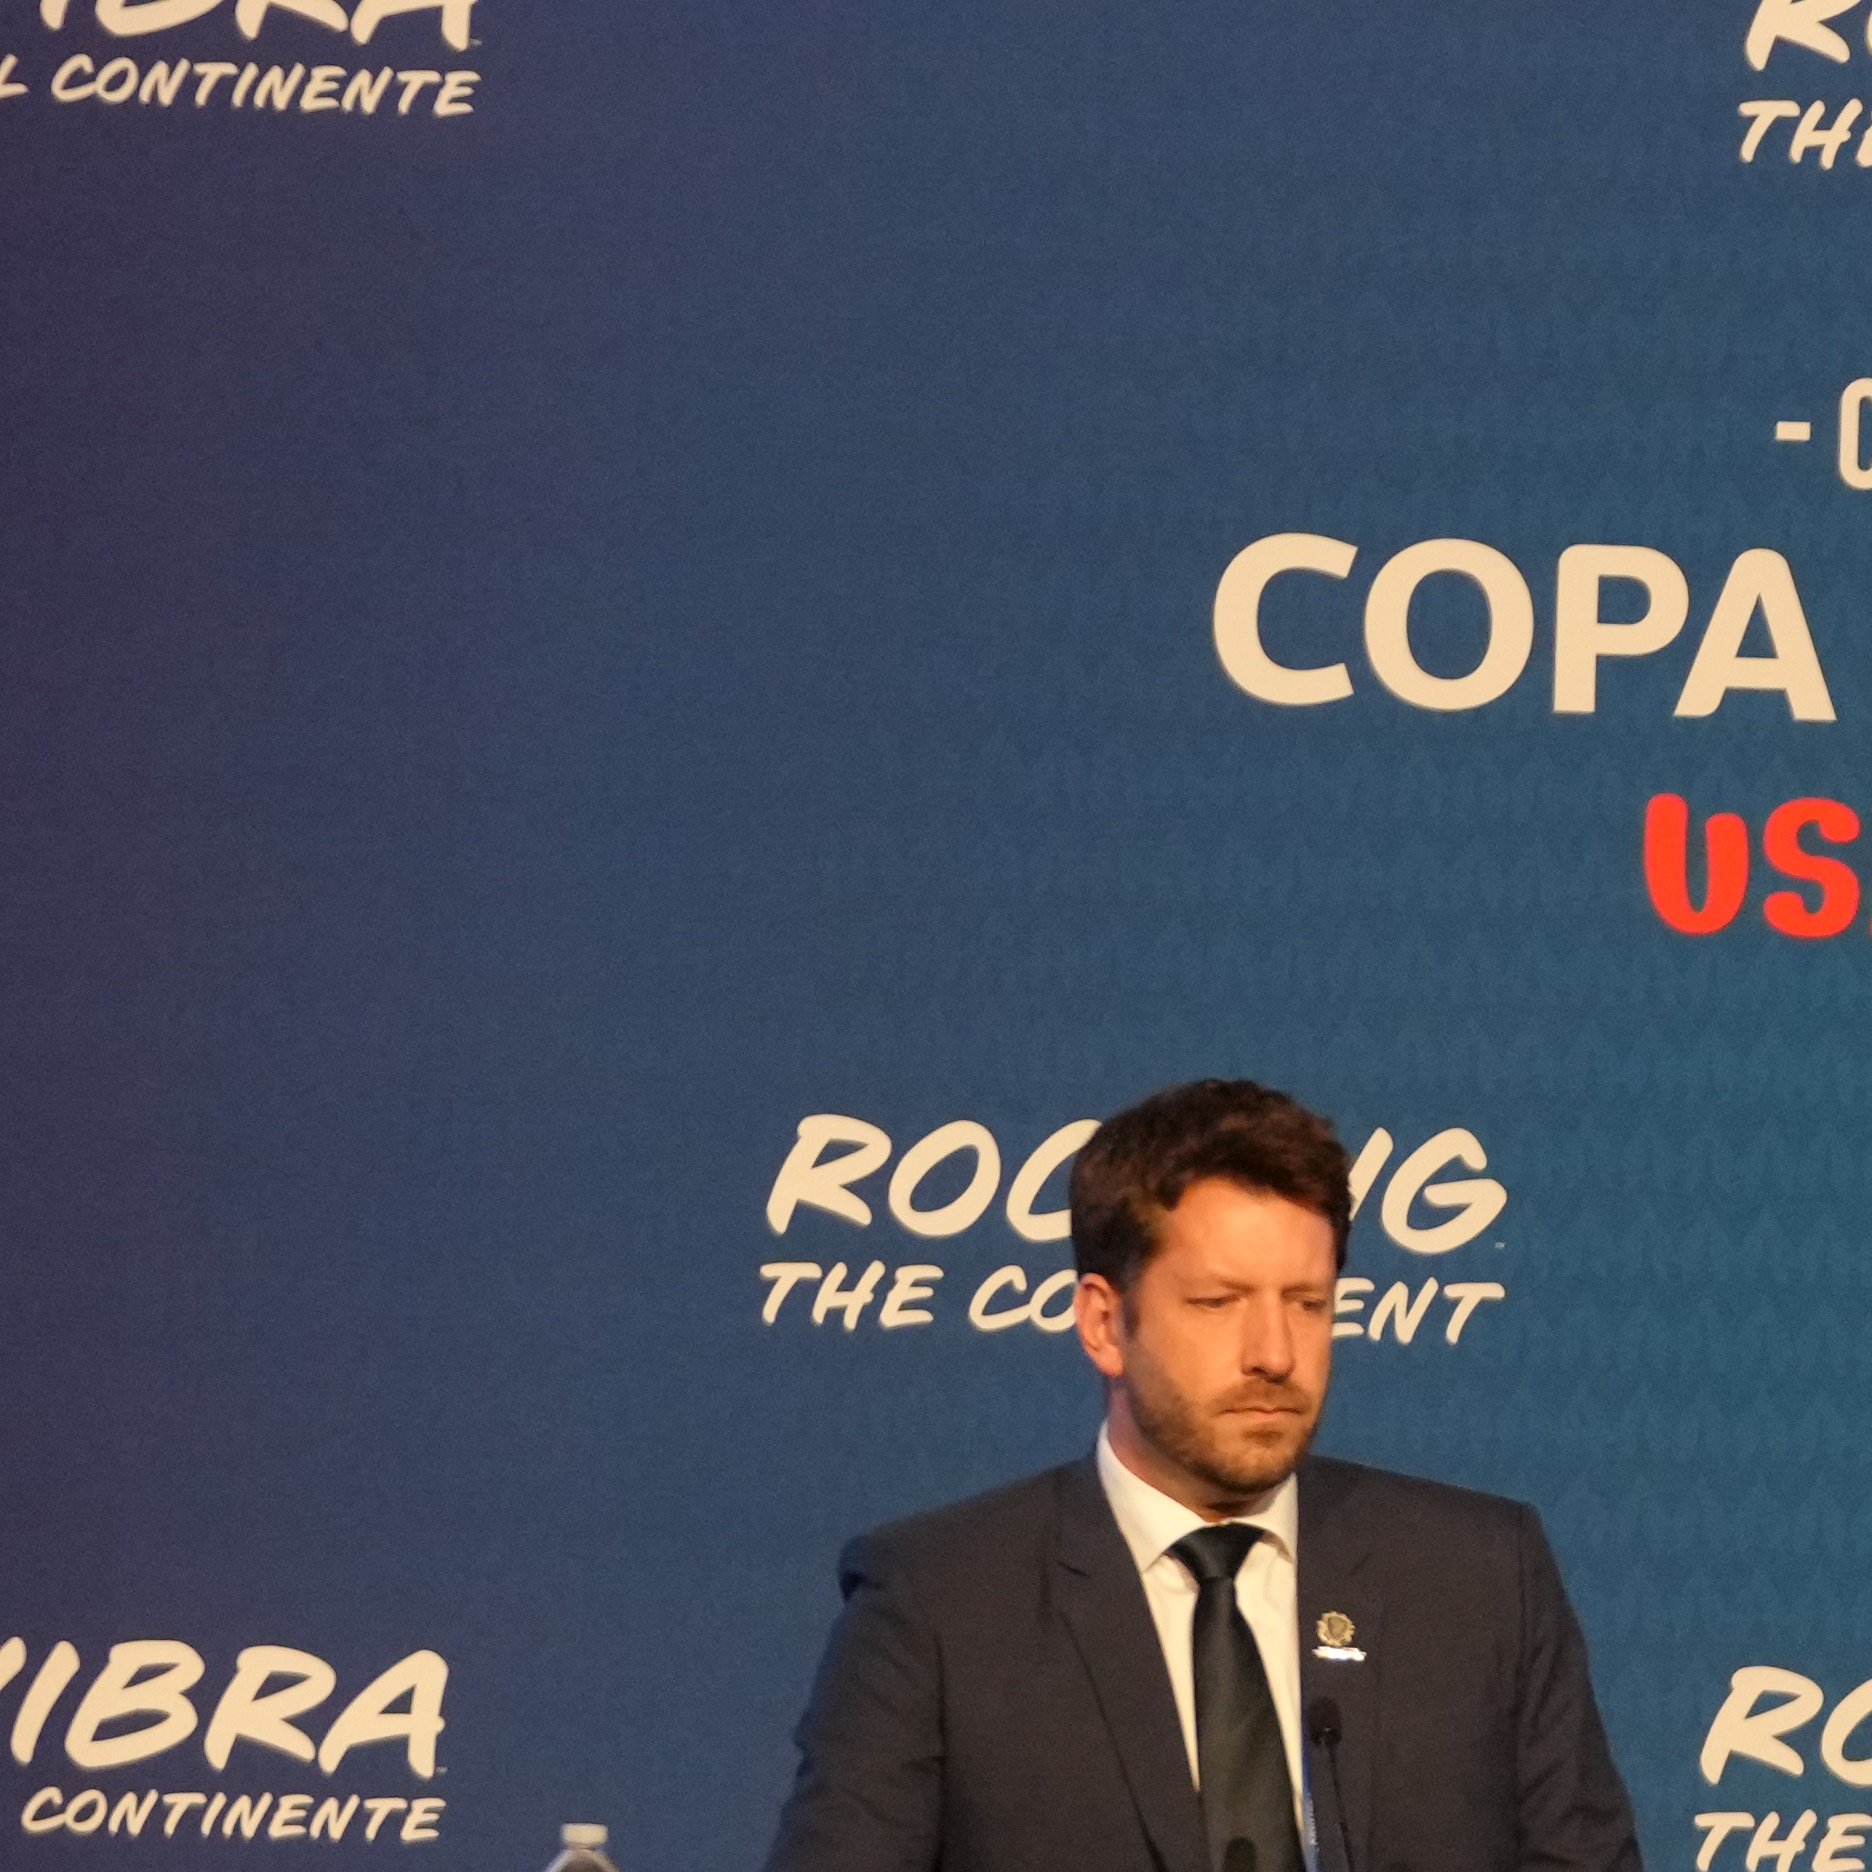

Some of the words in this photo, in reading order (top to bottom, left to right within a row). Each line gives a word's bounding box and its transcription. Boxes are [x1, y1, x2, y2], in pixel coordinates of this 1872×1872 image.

[51, 54, 481, 117] CONTINENTE
[1212, 532, 1838, 722] COPA
[766, 1113, 1509, 1255] ROCG
[759, 1260, 944, 1331] THE
[0, 1637, 449, 1780] IBRA
[21, 1786, 447, 1843] CONTINENTE
